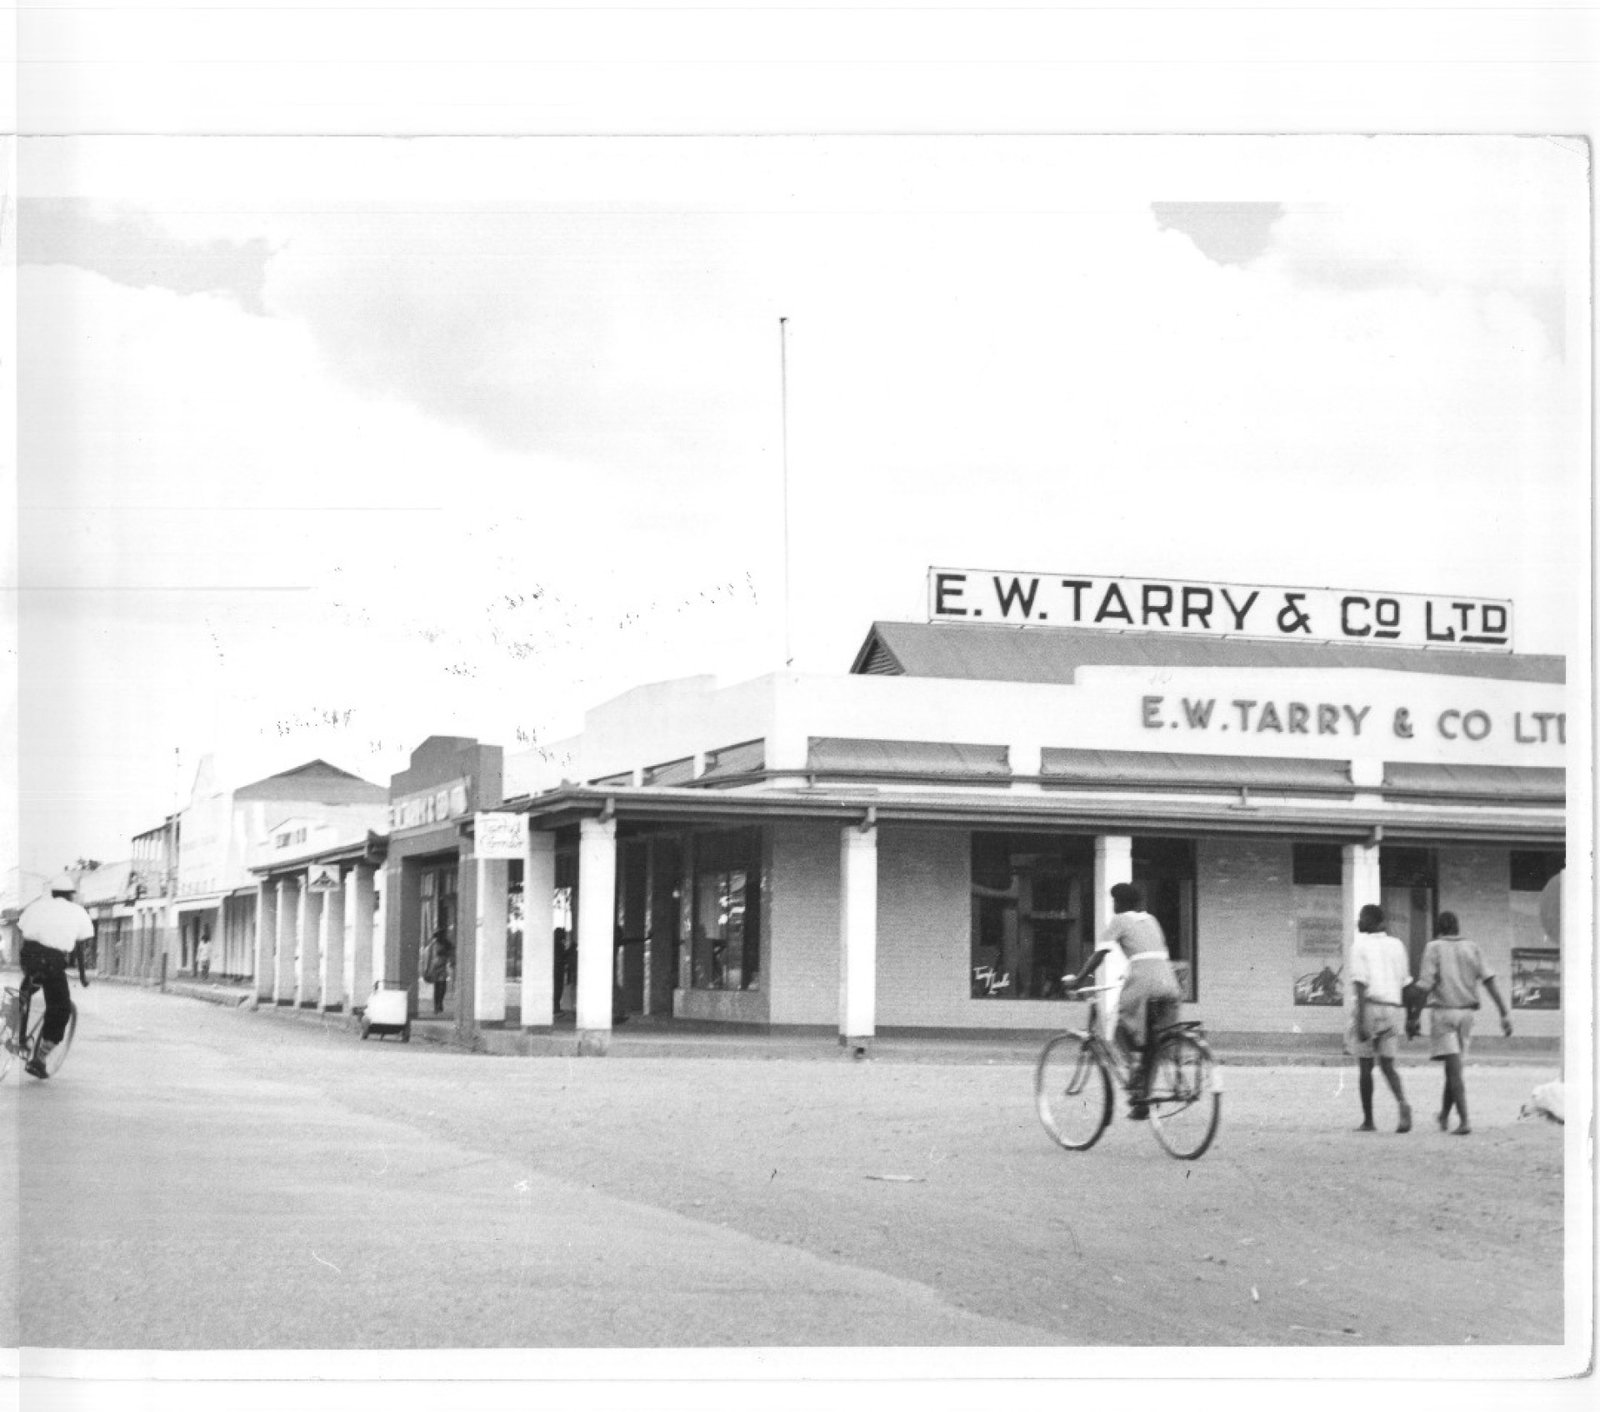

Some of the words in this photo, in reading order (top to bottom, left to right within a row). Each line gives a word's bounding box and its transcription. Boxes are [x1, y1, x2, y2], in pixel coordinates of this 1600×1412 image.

[1062, 580, 1259, 630] TARRY
[1277, 593, 1311, 633] &
[1393, 707, 1415, 739] &
[1437, 709, 1492, 742] CO
